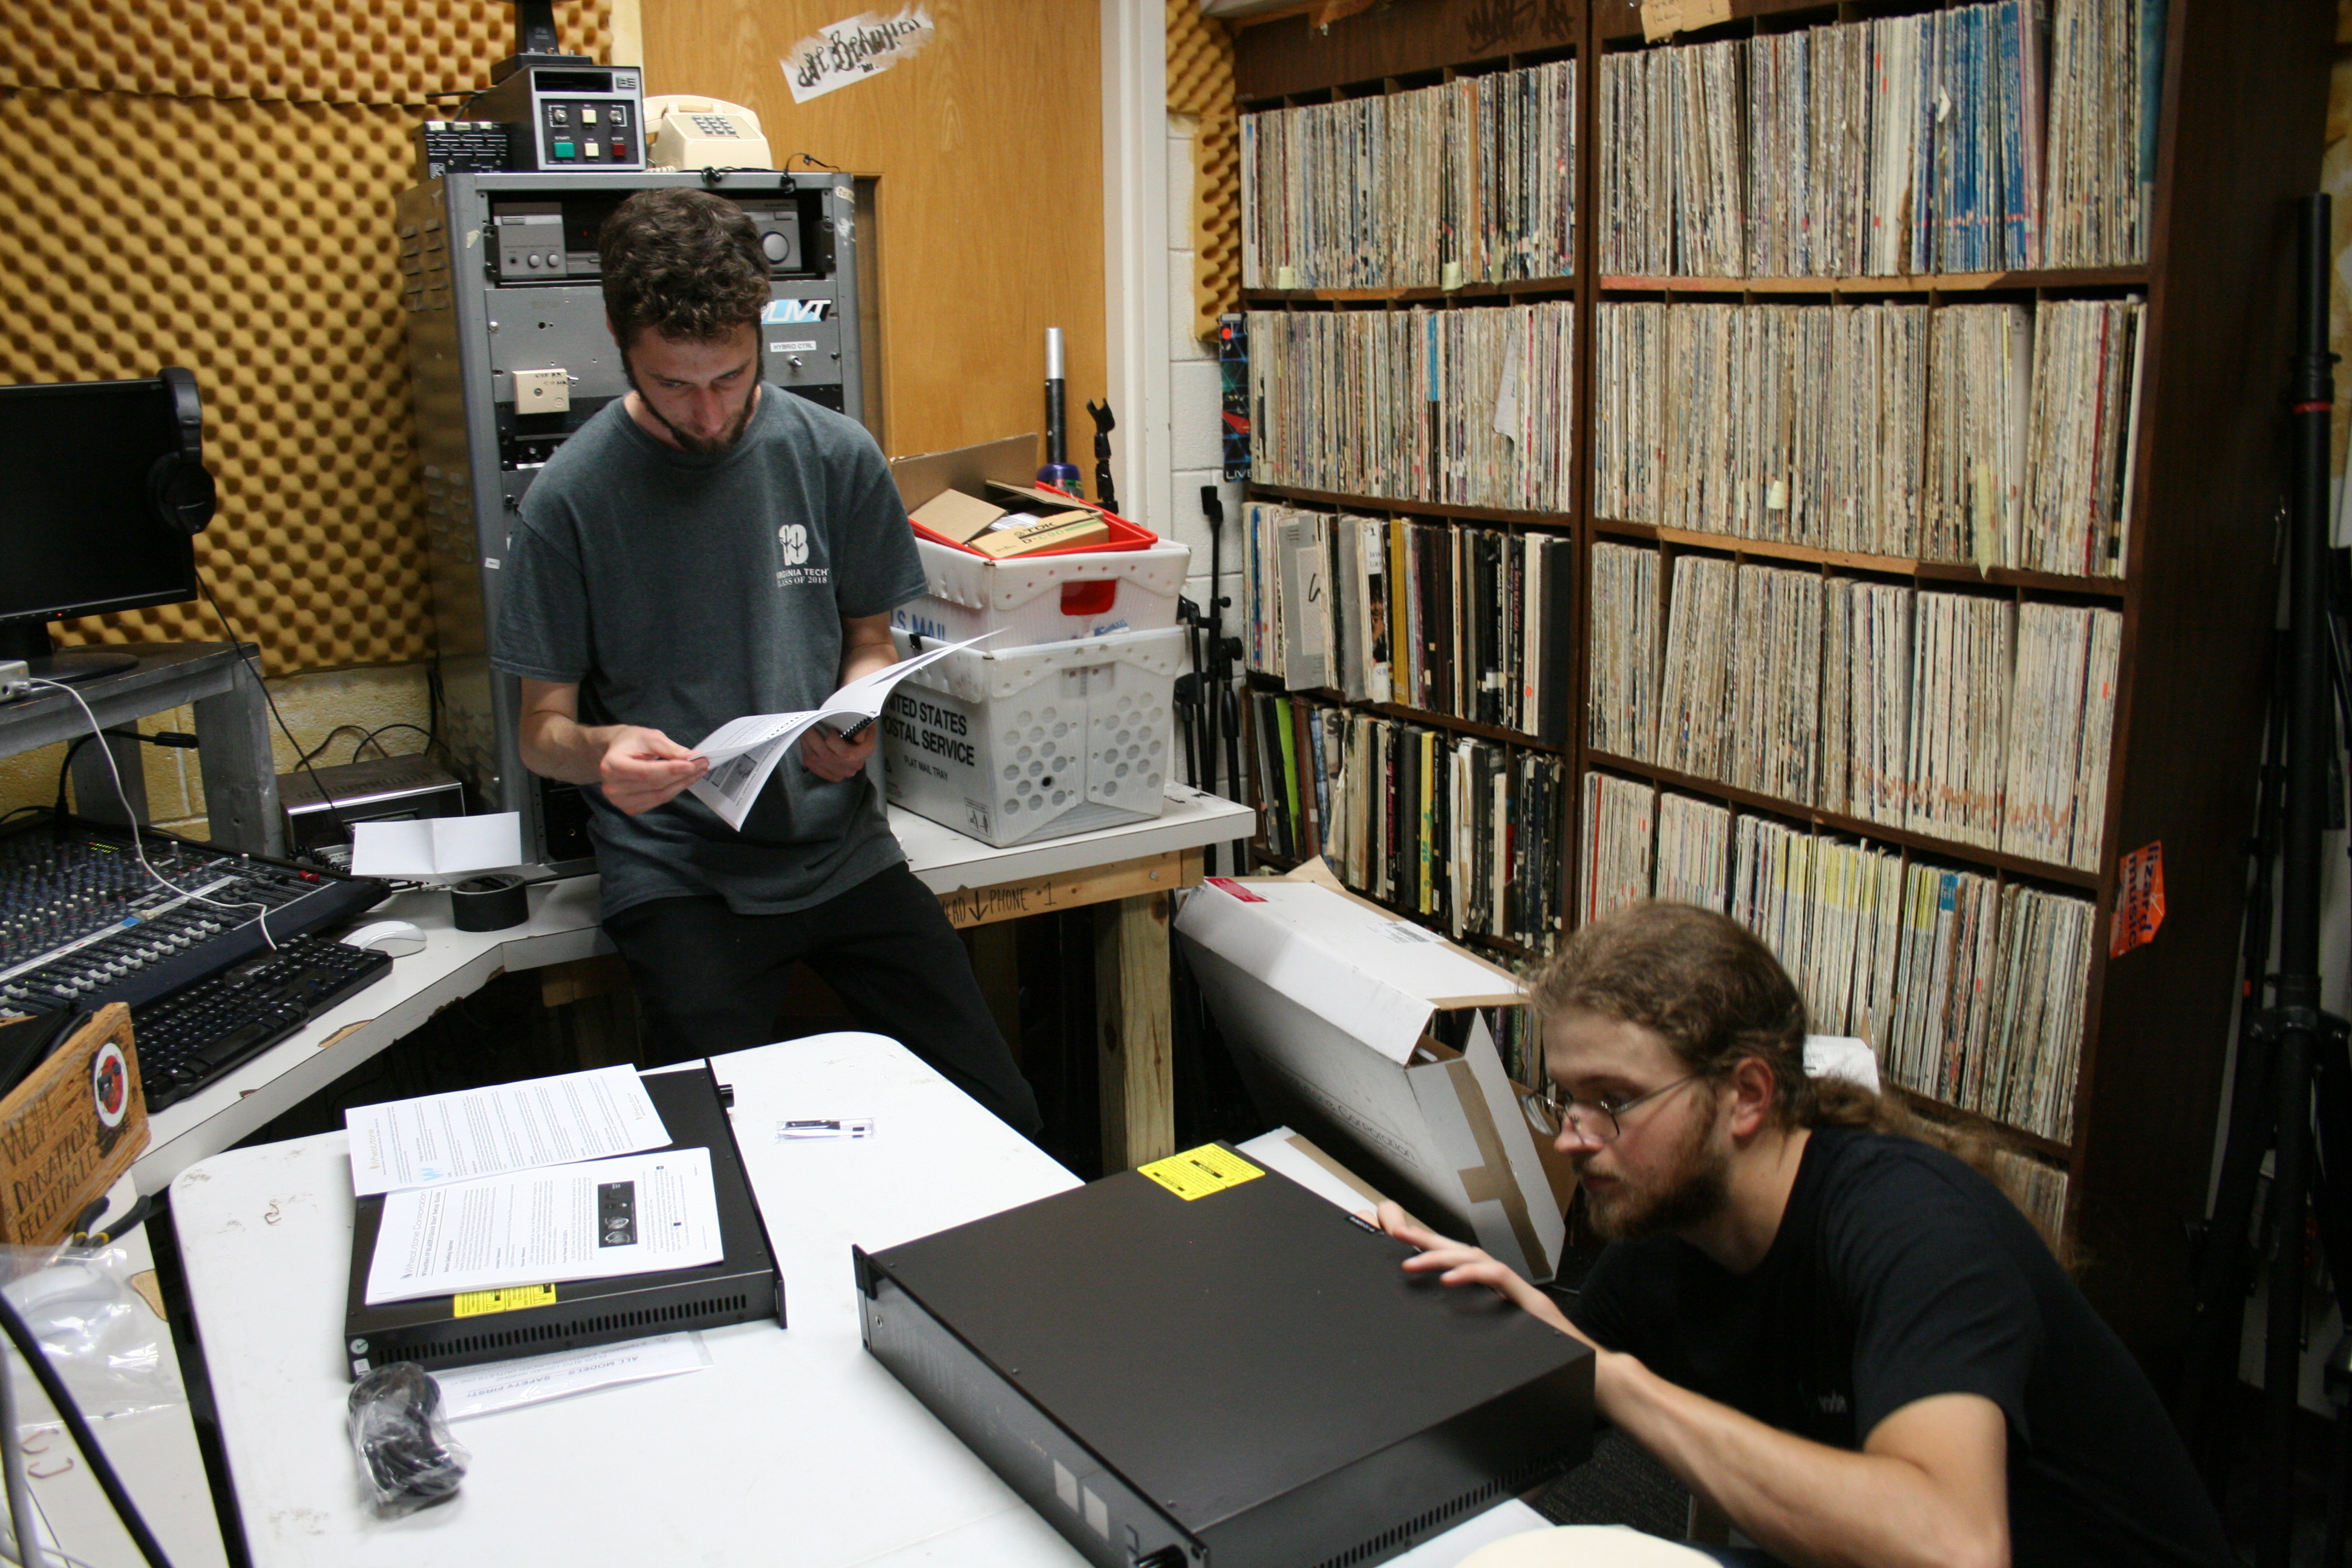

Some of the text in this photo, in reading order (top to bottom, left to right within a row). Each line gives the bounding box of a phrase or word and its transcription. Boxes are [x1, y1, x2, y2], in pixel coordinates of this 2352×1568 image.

[1023, 522, 1056, 534] TDK
[885, 693, 967, 736] NITED STATES
[884, 714, 975, 766] OSTAL SERVICE
[904, 756, 948, 782] FLAT MAIL TRAY
[988, 887, 1029, 913] PHONE
[13, 1113, 91, 1214] DONATION
[368, 1129, 380, 1165] Wheatstone
[18, 1146, 97, 1245] RECEPTACLE
[405, 1190, 428, 1273] Wheatstone Corporation
[467, 1356, 639, 1398] ALL MODELS SAFETY FIRST!
